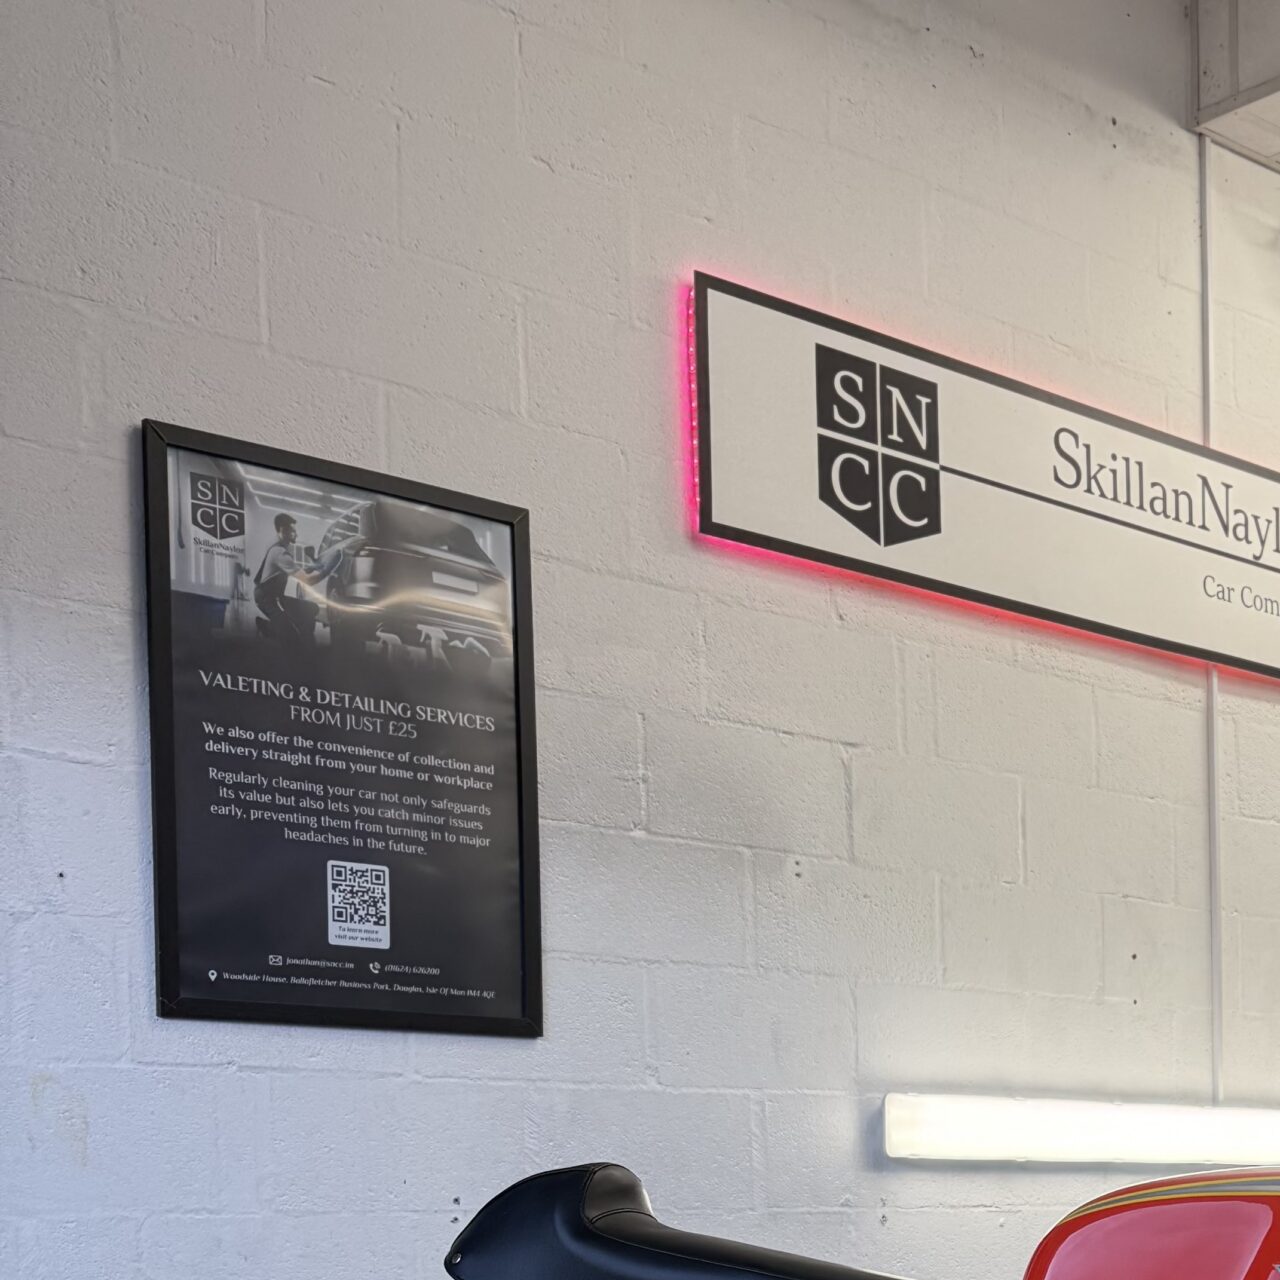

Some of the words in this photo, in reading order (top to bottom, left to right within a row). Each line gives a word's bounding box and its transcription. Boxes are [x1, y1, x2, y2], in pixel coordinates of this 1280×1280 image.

[1202, 574, 1235, 604] Car
[198, 669, 294, 699] VALETING
[298, 686, 311, 702] &
[316, 689, 411, 718] DETAILING
[416, 705, 495, 732] SERVICES
[290, 705, 341, 728] FROM
[346, 713, 384, 733] JUST
[388, 721, 417, 739] £25
[202, 721, 224, 736] We
[227, 726, 255, 740] also
[258, 731, 290, 745] offer
[293, 736, 314, 749] the
[317, 741, 395, 761] convenience
[397, 752, 411, 763] of
[413, 755, 471, 772] collection
[473, 764, 494, 775] and
[205, 740, 258, 760] delivery
[262, 749, 312, 766] straight
[315, 755, 346, 770] from
[349, 762, 378, 774] your
[380, 764, 414, 780] home
[417, 771, 430, 782] or
[433, 774, 493, 790] workplace
[208, 767, 269, 788] Regularly
[272, 776, 323, 796] cleaning
[327, 785, 356, 797] your
[358, 789, 377, 800] car
[380, 792, 399, 804] not
[402, 795, 428, 809] only
[431, 799, 491, 816] safeguards
[219, 786, 235, 799] its
[239, 790, 272, 804] value
[275, 792, 296, 806] but
[299, 797, 324, 810] also
[328, 799, 350, 813] lets
[353, 805, 375, 816] you
[378, 807, 409, 821] catch
[412, 812, 446, 825] minor
[449, 817, 483, 830] issues
[210, 804, 247, 819] early,
[250, 809, 318, 828] preventing
[321, 816, 351, 830] them
[354, 819, 383, 833] from
[386, 824, 428, 841] turning
[431, 830, 442, 840] in
[445, 832, 456, 843] to
[459, 836, 491, 848] major
[284, 828, 349, 846] headaches
[352, 836, 363, 847] in
[367, 838, 385, 850] the
[388, 840, 427, 856] future.
[222, 971, 260, 982] Woodside
[290, 976, 337, 987] Ballafletcher
[339, 980, 371, 989] Business
[426, 986, 439, 994] Isle
[440, 987, 449, 996] Of
[450, 988, 466, 997] Man
